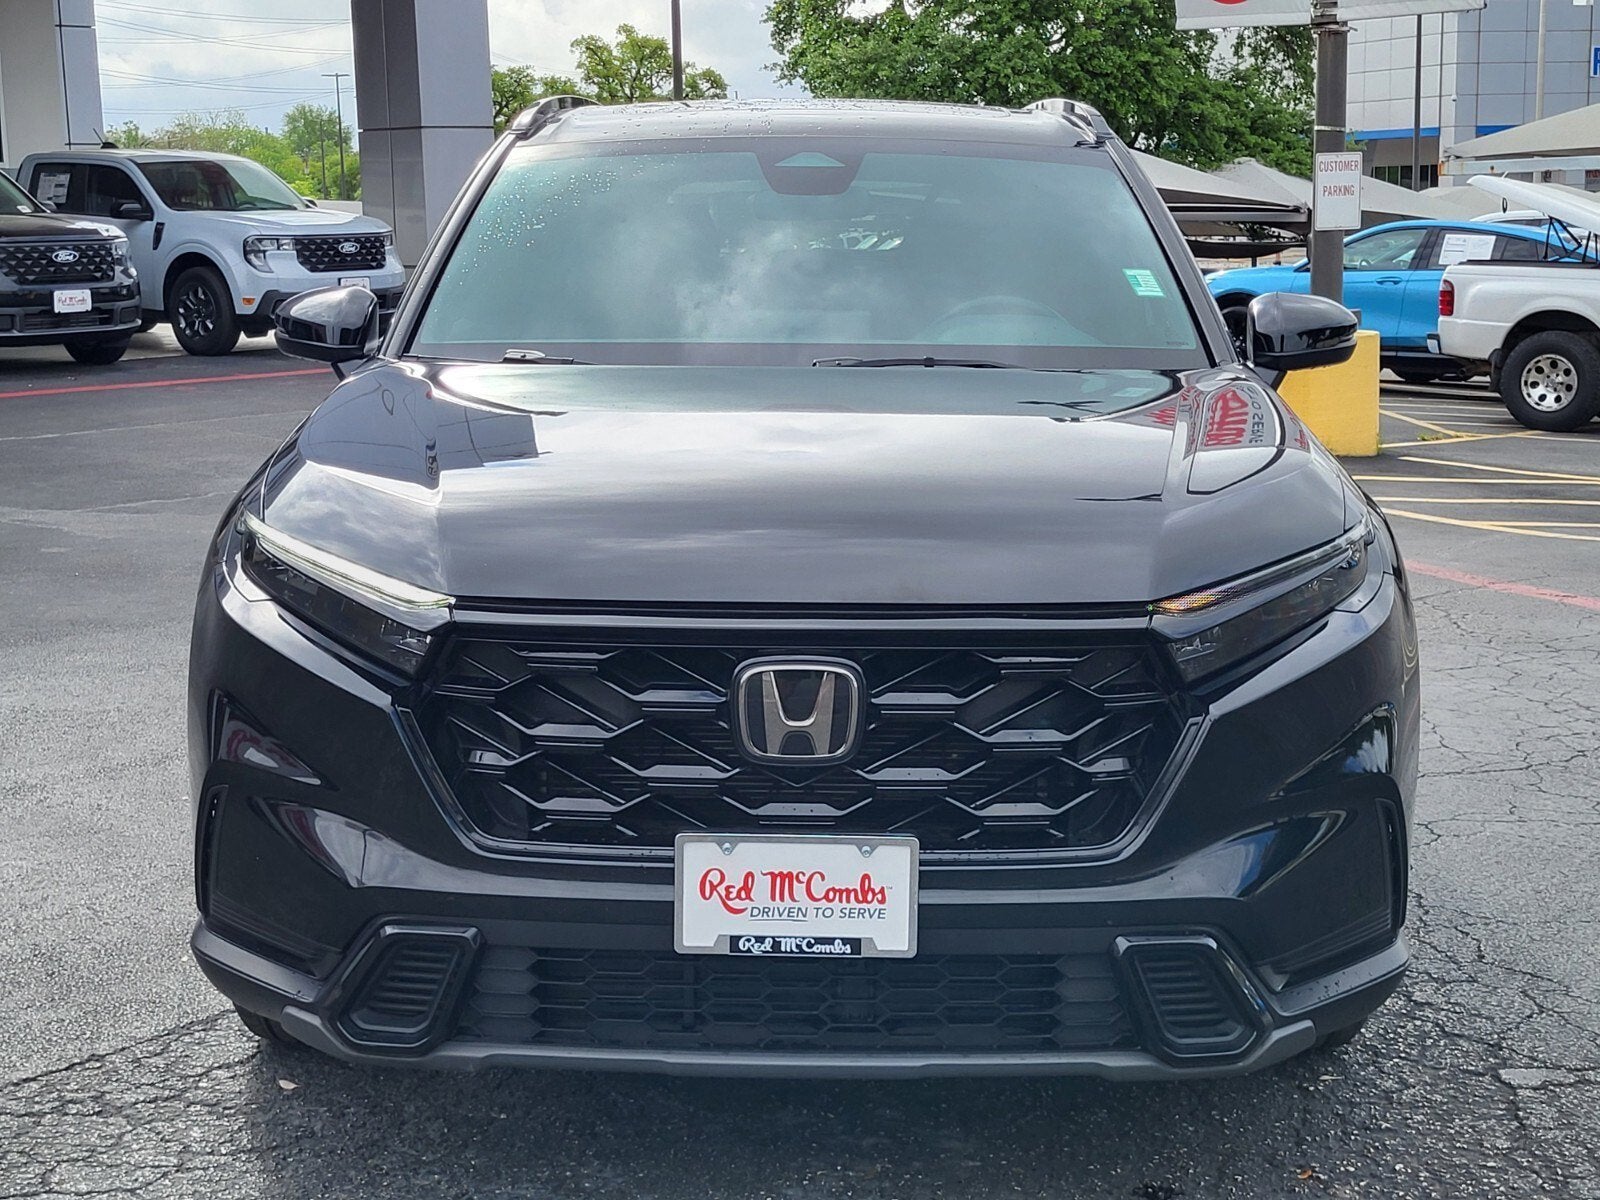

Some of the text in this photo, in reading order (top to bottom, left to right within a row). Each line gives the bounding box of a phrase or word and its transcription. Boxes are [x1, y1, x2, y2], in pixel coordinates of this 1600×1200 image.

[1319, 160, 1359, 172] CUSTOMER
[1323, 184, 1355, 197] PARKING
[699, 868, 887, 915] Red McCombs
[750, 906, 886, 919] DRIVEN TO SERVE
[738, 936, 852, 954] Red McCombs
